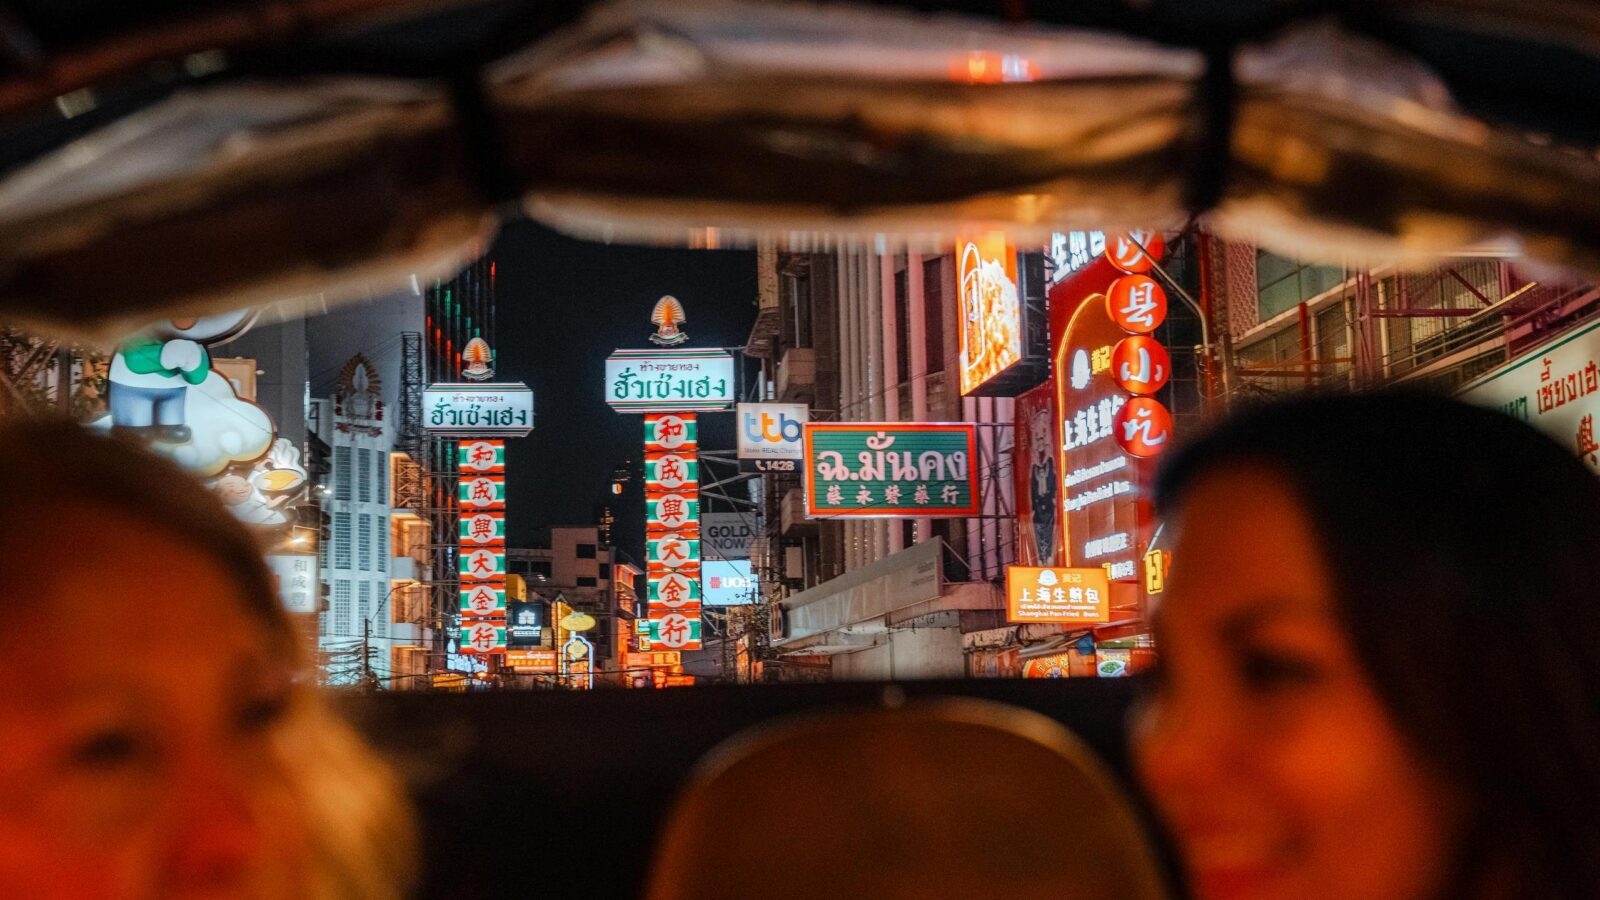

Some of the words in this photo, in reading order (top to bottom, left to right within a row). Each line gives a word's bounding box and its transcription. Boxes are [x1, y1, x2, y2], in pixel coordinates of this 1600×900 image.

[614, 368, 727, 400] ฮั่วเซ่งเฮง
[431, 398, 527, 427] ฮั่วเซ่งเฮง
[744, 412, 802, 442] ttb
[765, 460, 795, 471] 1428
[817, 431, 968, 481] ฉ.มั่นคง
[708, 526, 750, 538] GOLD
[713, 538, 747, 550] NOW
[722, 577, 752, 588] UOB
